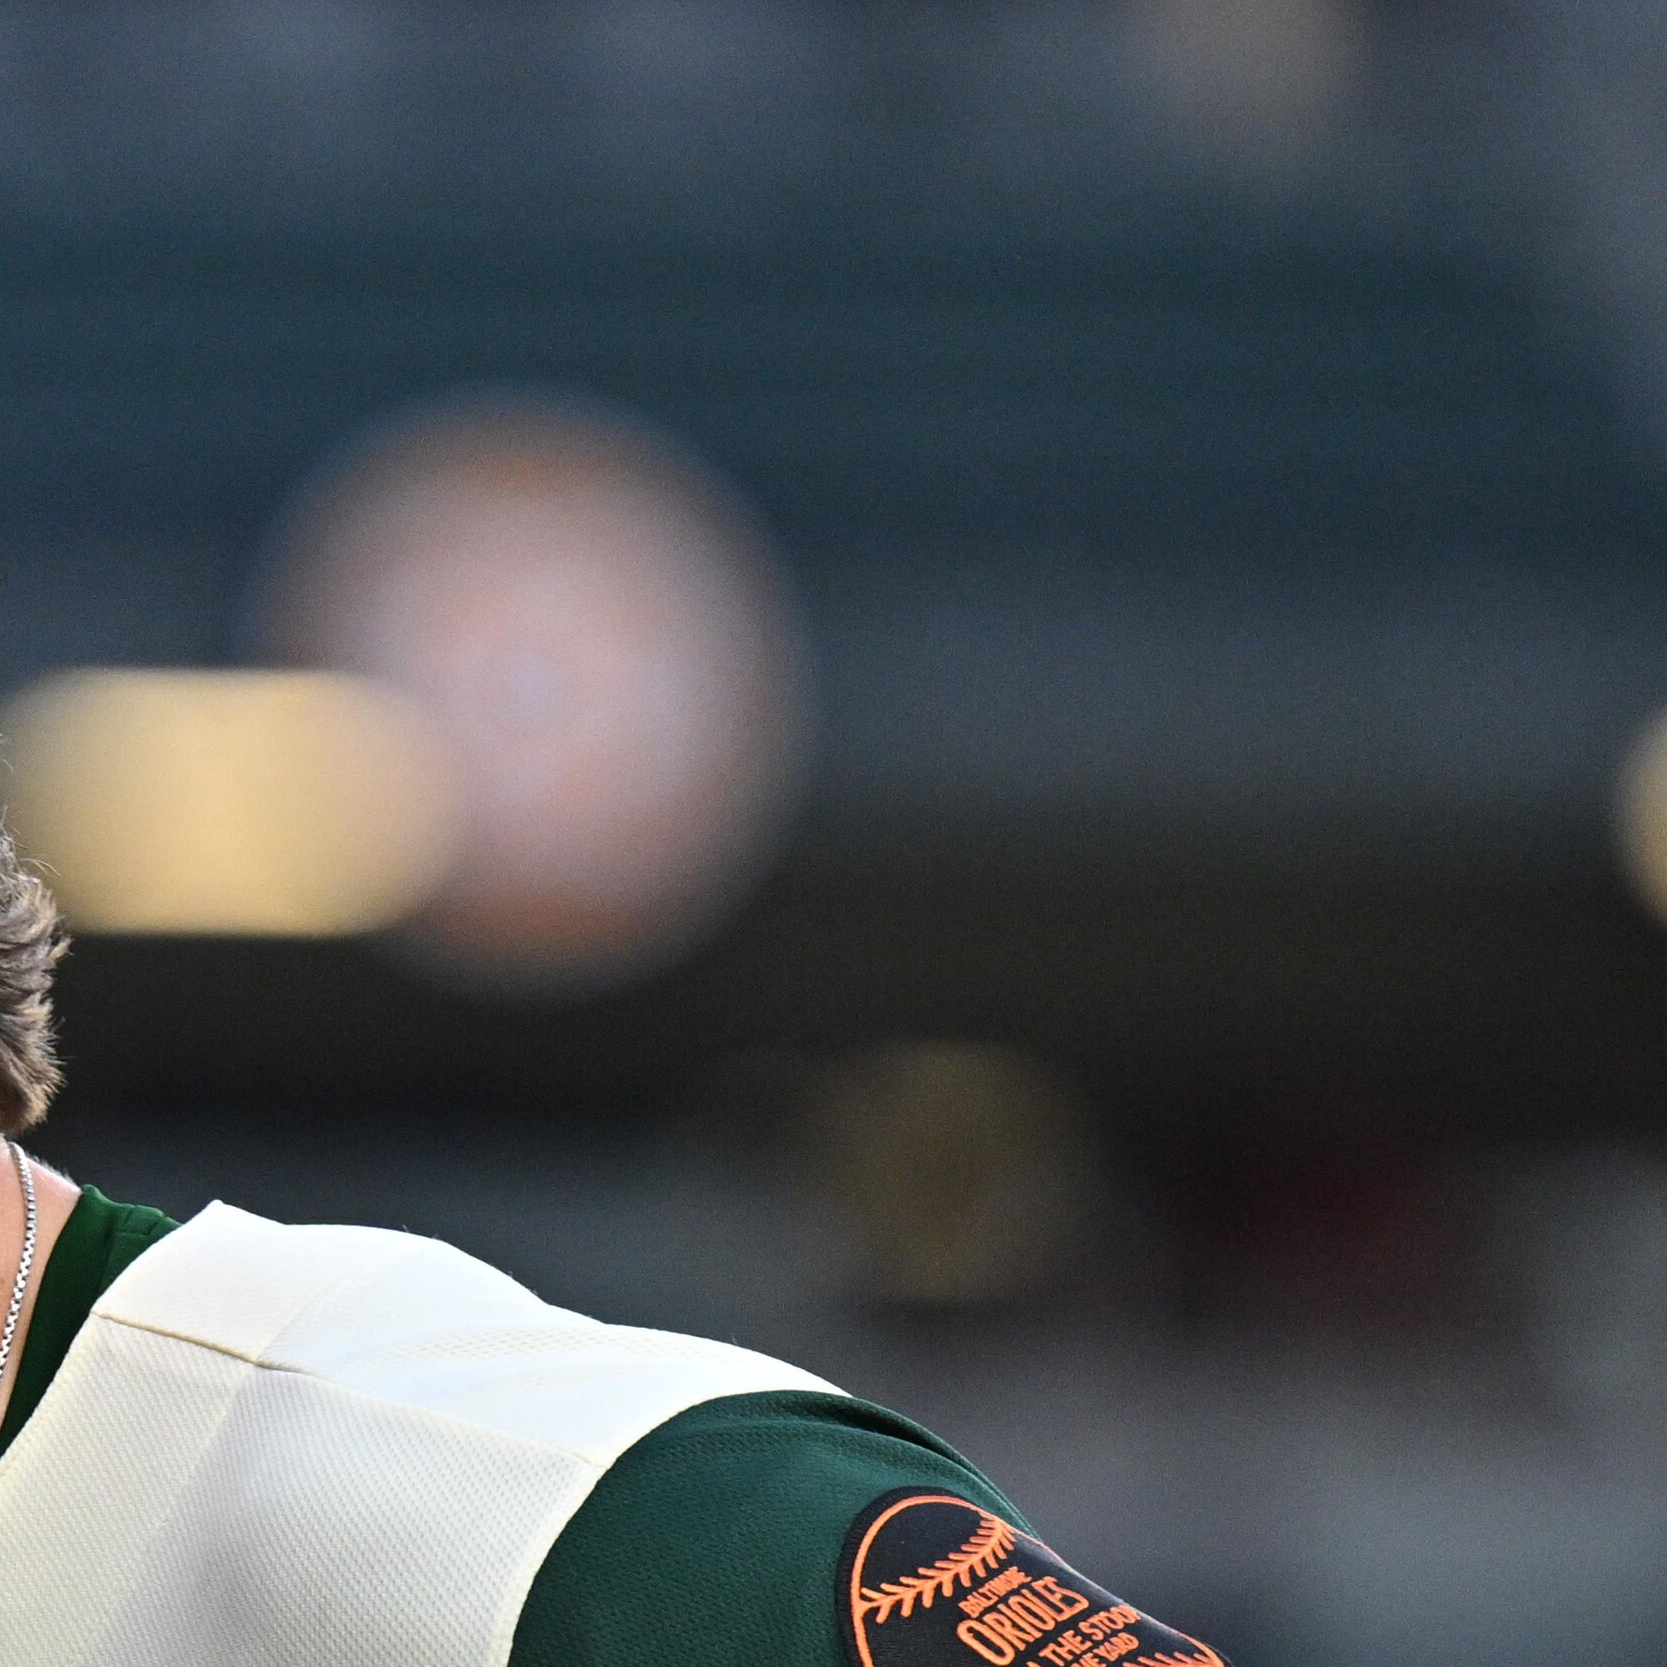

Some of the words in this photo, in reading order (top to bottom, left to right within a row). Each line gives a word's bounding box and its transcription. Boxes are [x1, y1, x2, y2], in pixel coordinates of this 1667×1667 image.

[957, 1576, 1089, 1666] ORIOLES
[1038, 1630, 1092, 1667] THE
[1093, 1632, 1139, 1661] YARD
